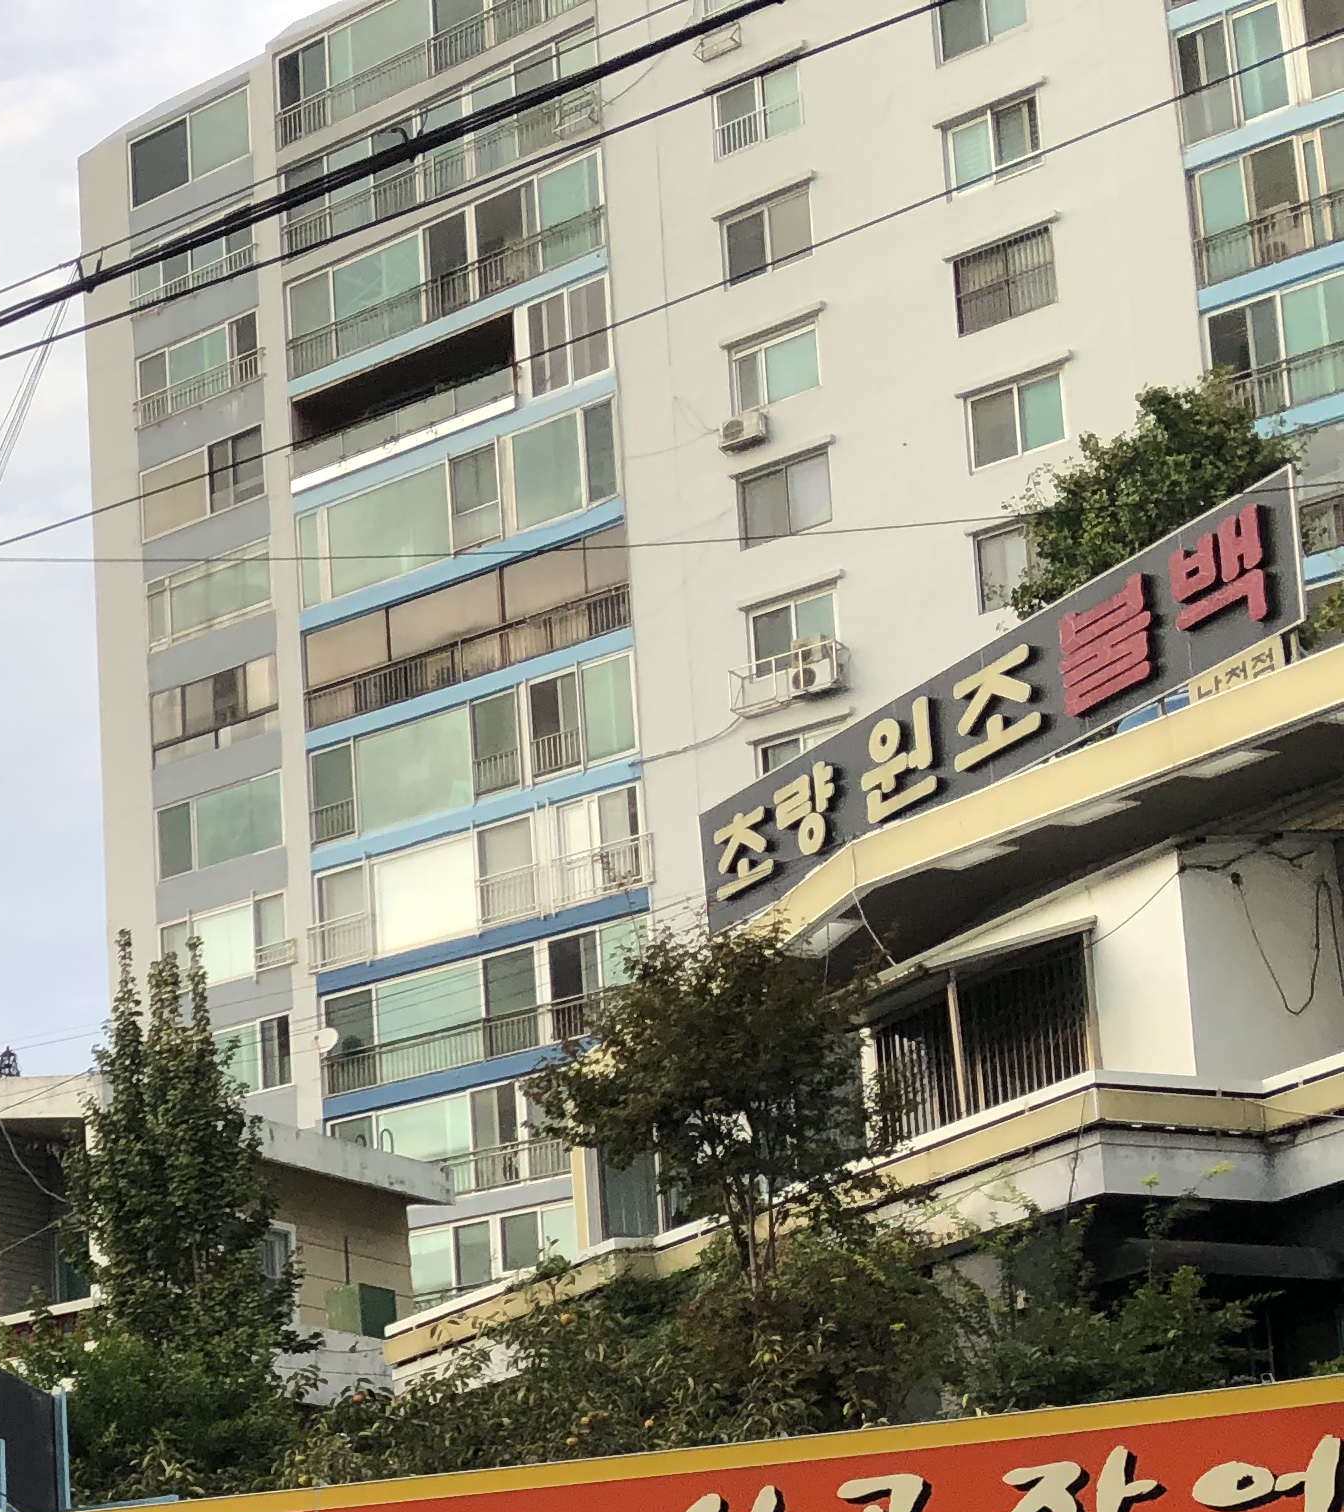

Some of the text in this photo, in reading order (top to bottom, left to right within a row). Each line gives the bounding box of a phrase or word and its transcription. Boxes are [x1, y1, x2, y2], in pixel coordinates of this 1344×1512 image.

[714, 503, 1268, 902] 초량 원조 불백
